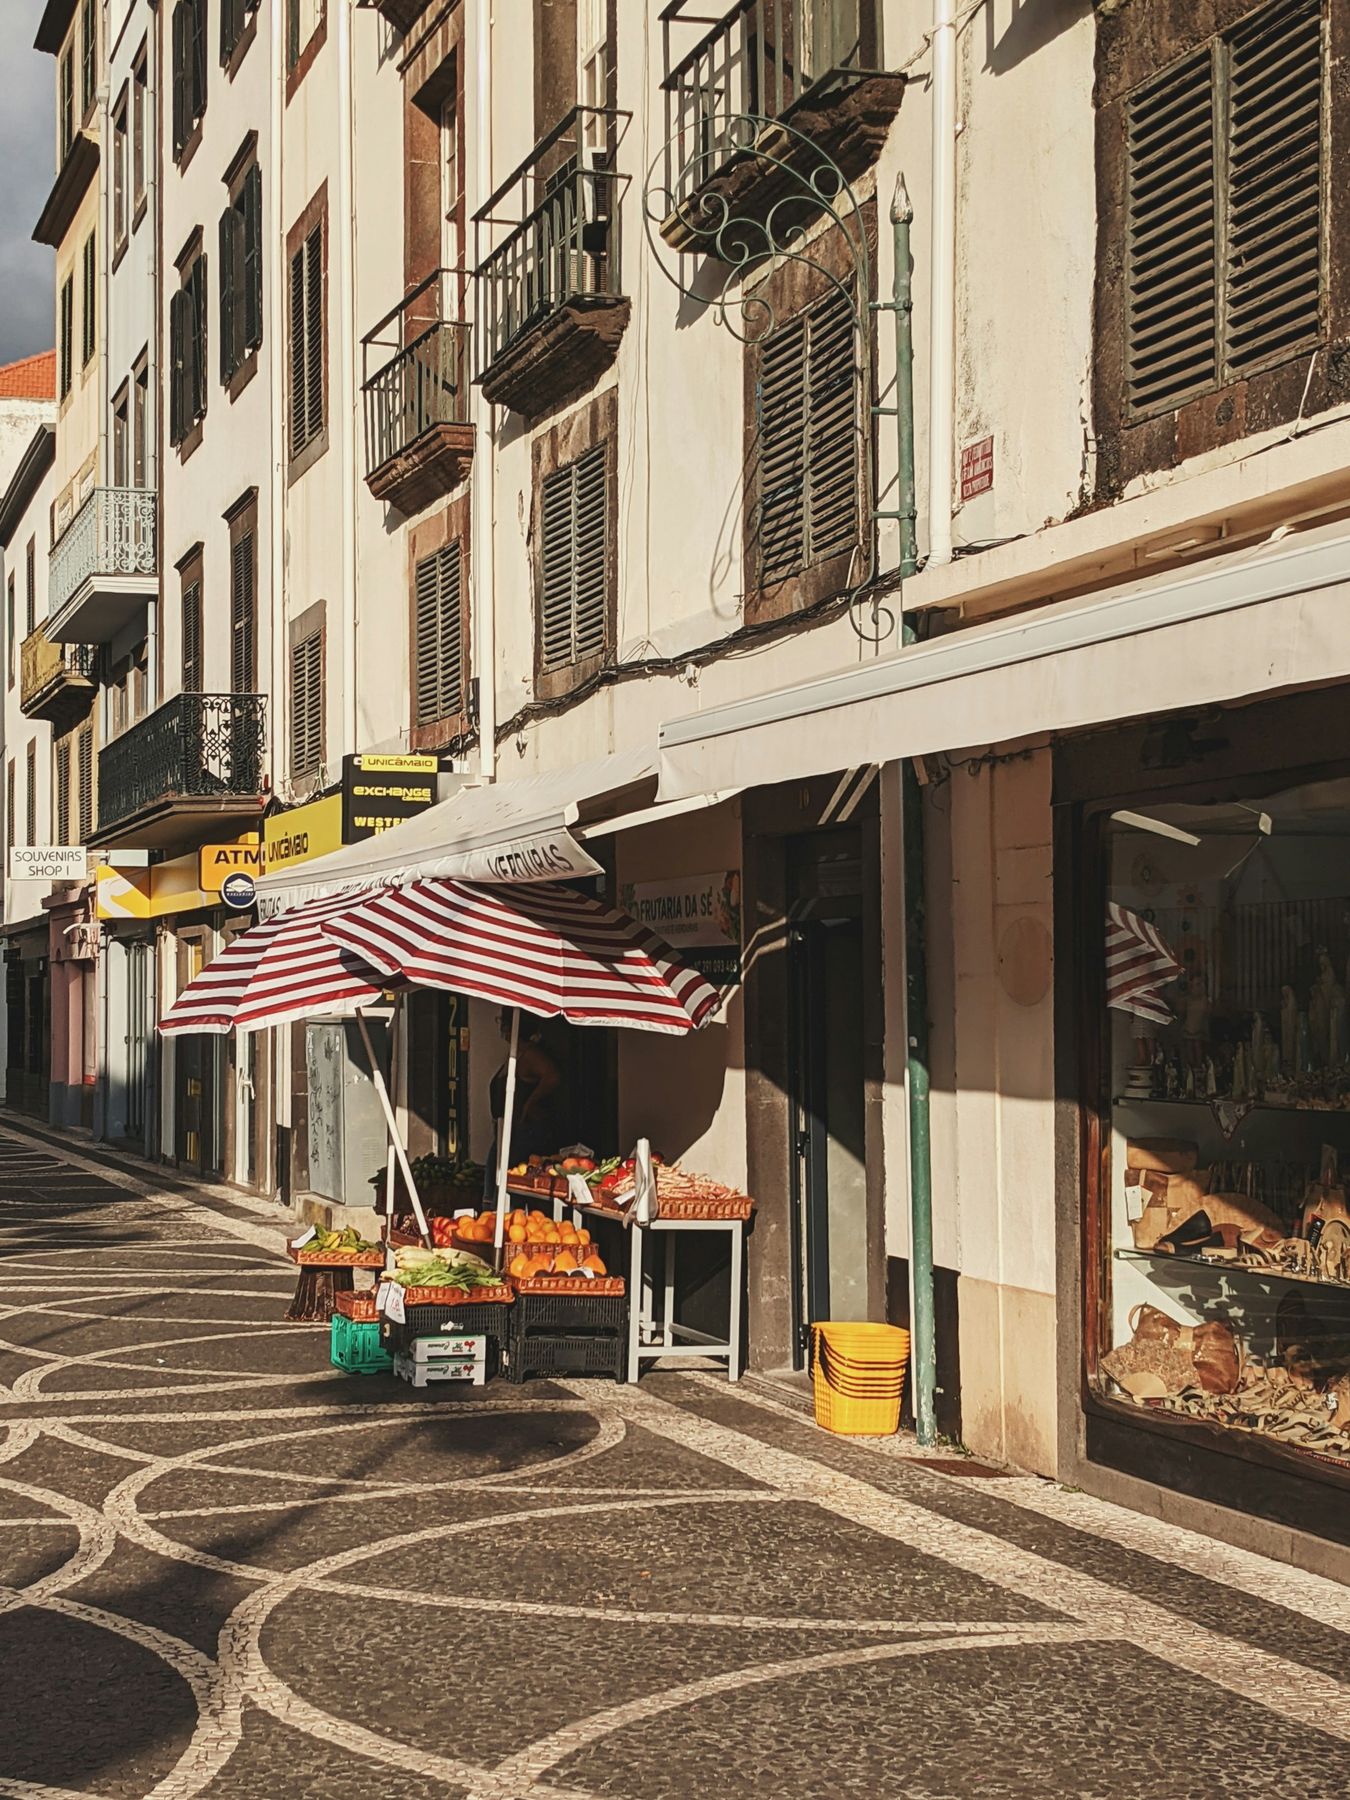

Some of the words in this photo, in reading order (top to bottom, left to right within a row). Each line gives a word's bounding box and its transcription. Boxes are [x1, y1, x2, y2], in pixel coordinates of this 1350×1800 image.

[14, 850, 82, 862] SOUVENIRS
[214, 849, 260, 865] ATM
[28, 865, 63, 877] SHOP
[640, 895, 683, 921] FRUTARIA
[684, 894, 699, 918] DA
[700, 886, 713, 917] SÉ
